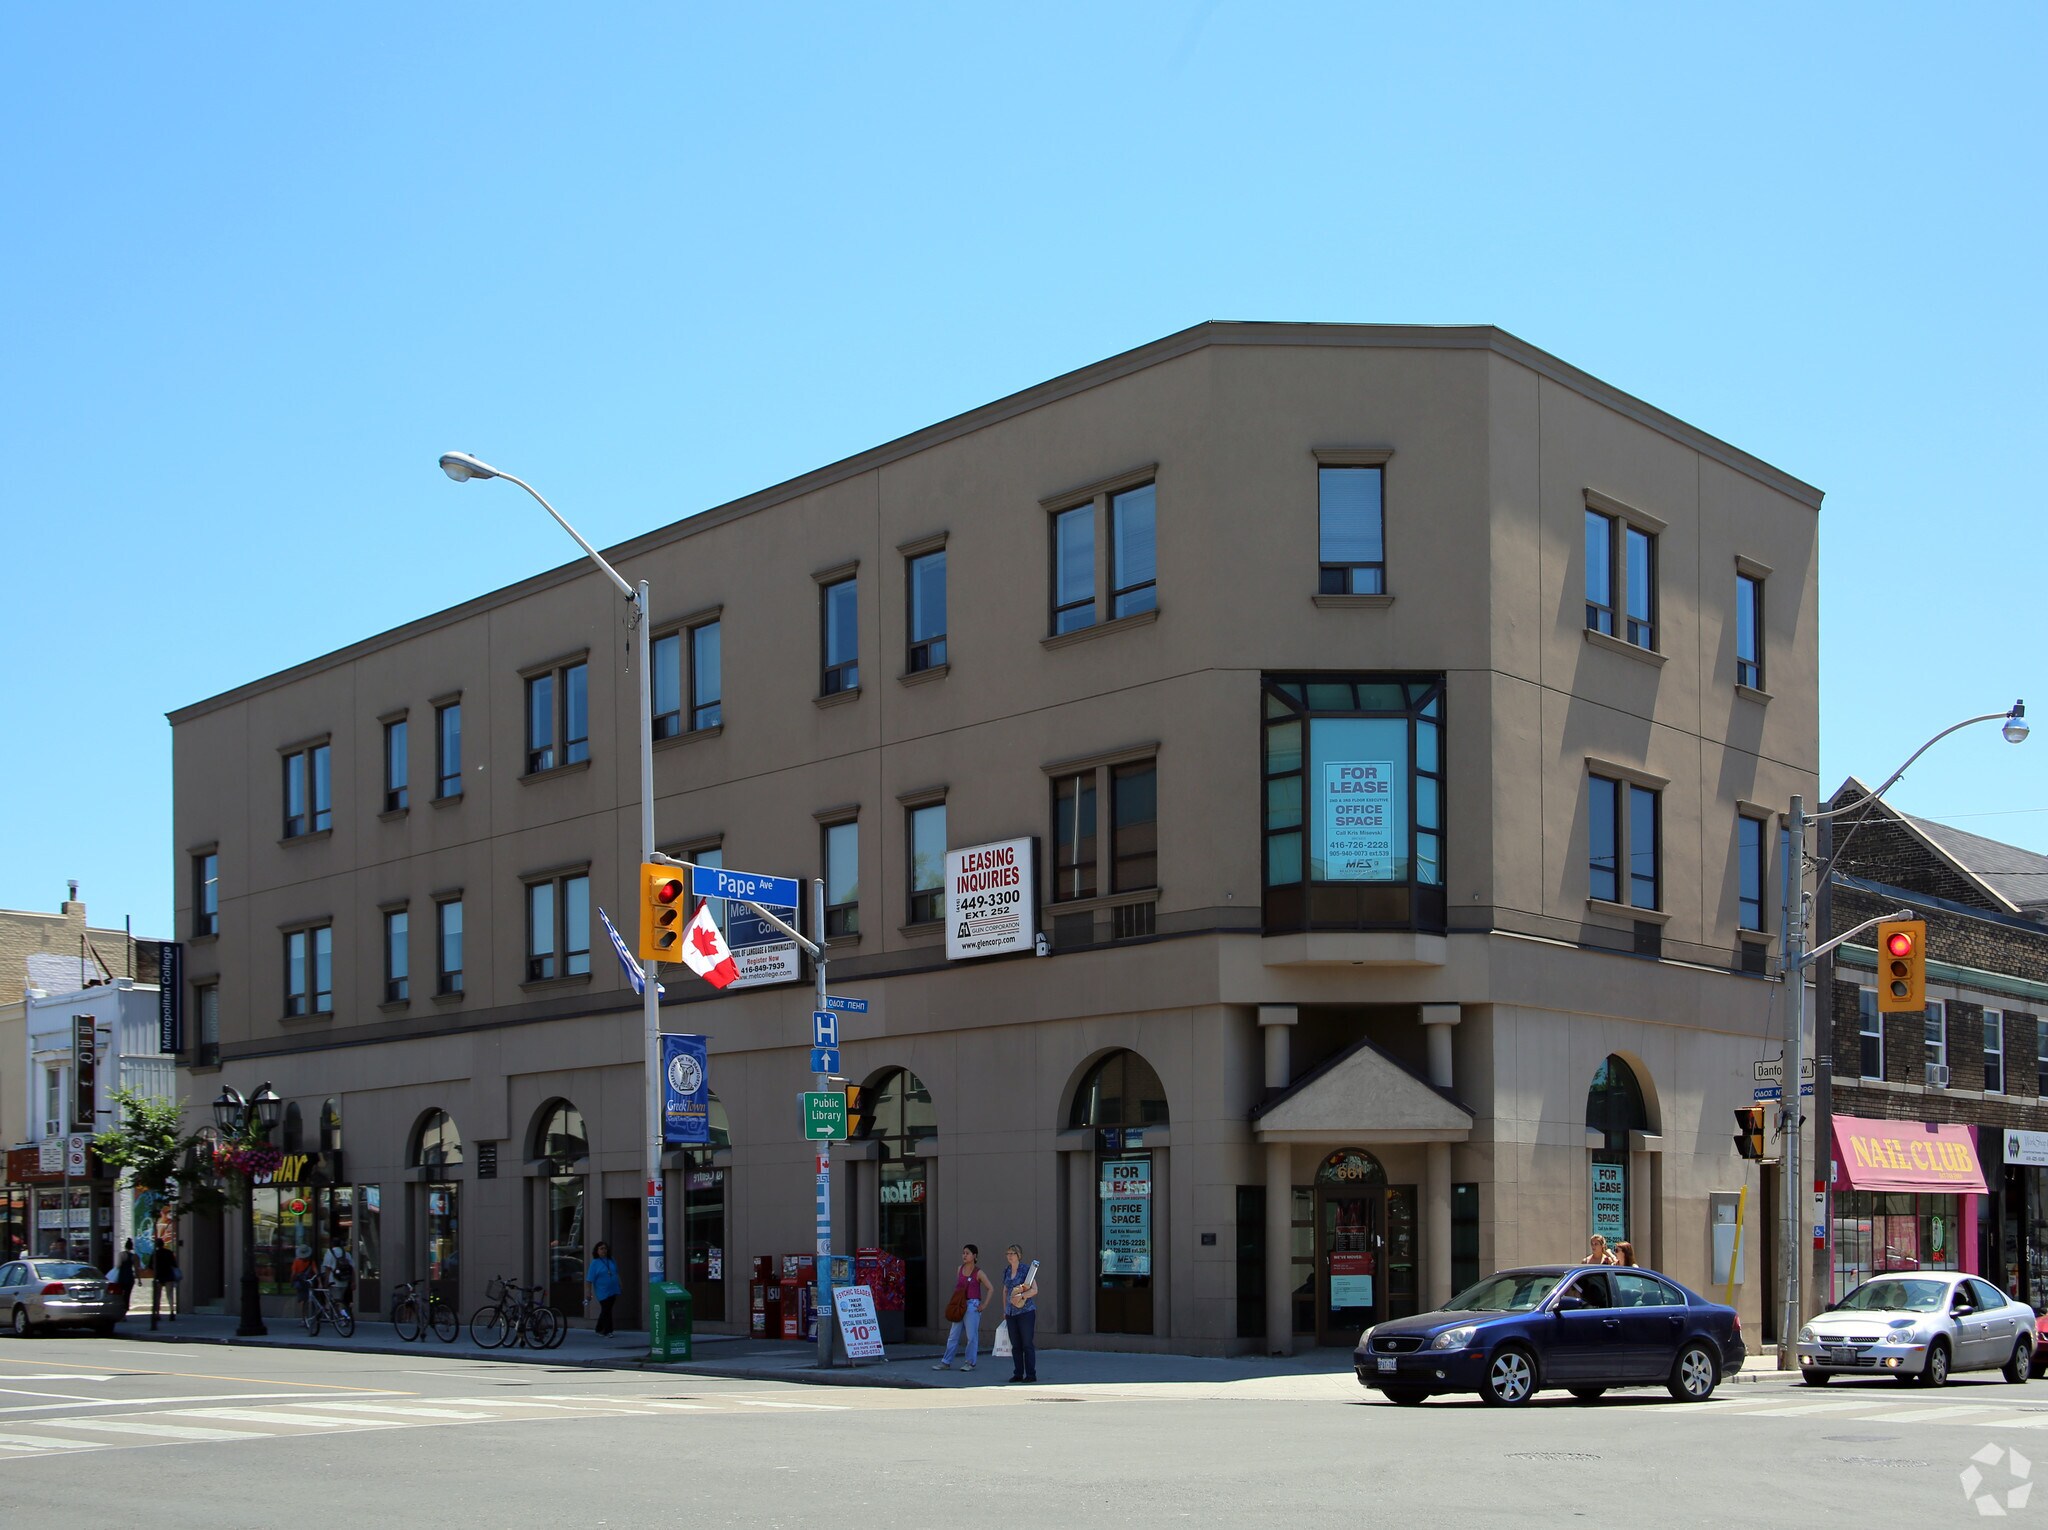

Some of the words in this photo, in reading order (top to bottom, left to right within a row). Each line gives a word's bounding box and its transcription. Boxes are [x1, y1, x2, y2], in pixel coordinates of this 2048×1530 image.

[1341, 767, 1377, 779] FOR
[1330, 782, 1388, 793] LEASE
[1336, 805, 1382, 814] OFFICE
[1336, 817, 1382, 826] SPACE
[962, 847, 1014, 873] LEASING
[719, 873, 755, 897] Pape
[760, 880, 772, 890] Ave
[957, 866, 1019, 894] INQUIRIES
[961, 890, 1020, 910] 449-3300
[966, 910, 987, 920] EXT.
[991, 907, 1009, 916] 252
[985, 922, 1019, 932] CORPORATION
[962, 936, 1015, 949] www.glencorp.com
[742, 949, 746, 957] OF
[747, 946, 763, 956] LANGUAGE
[768, 943, 796, 953] COMMUNICATION
[162, 946, 172, 984] College
[747, 956, 766, 965] Register
[741, 962, 784, 974] 416-849-7939
[162, 988, 173, 1050] Metropolitan
[817, 1017, 834, 1043] H
[814, 1098, 839, 1108] Public
[812, 1111, 841, 1122] Library
[1850, 1136, 1912, 1170] NAIL
[1910, 1140, 1973, 1172] CLUB
[1113, 1167, 1138, 1178] FOR
[1337, 1167, 1363, 1179] 661
[1600, 1170, 1616, 1180] FOR
[1594, 1182, 1621, 1193] LEASE
[1110, 1205, 1142, 1214] OFFICE
[1598, 1203, 1619, 1212] OFFICE
[1112, 1216, 1140, 1224] SPACE
[1598, 1214, 1619, 1222] SPACE
[836, 1289, 854, 1300] PSYCHIC
[854, 1289, 871, 1298] READER
